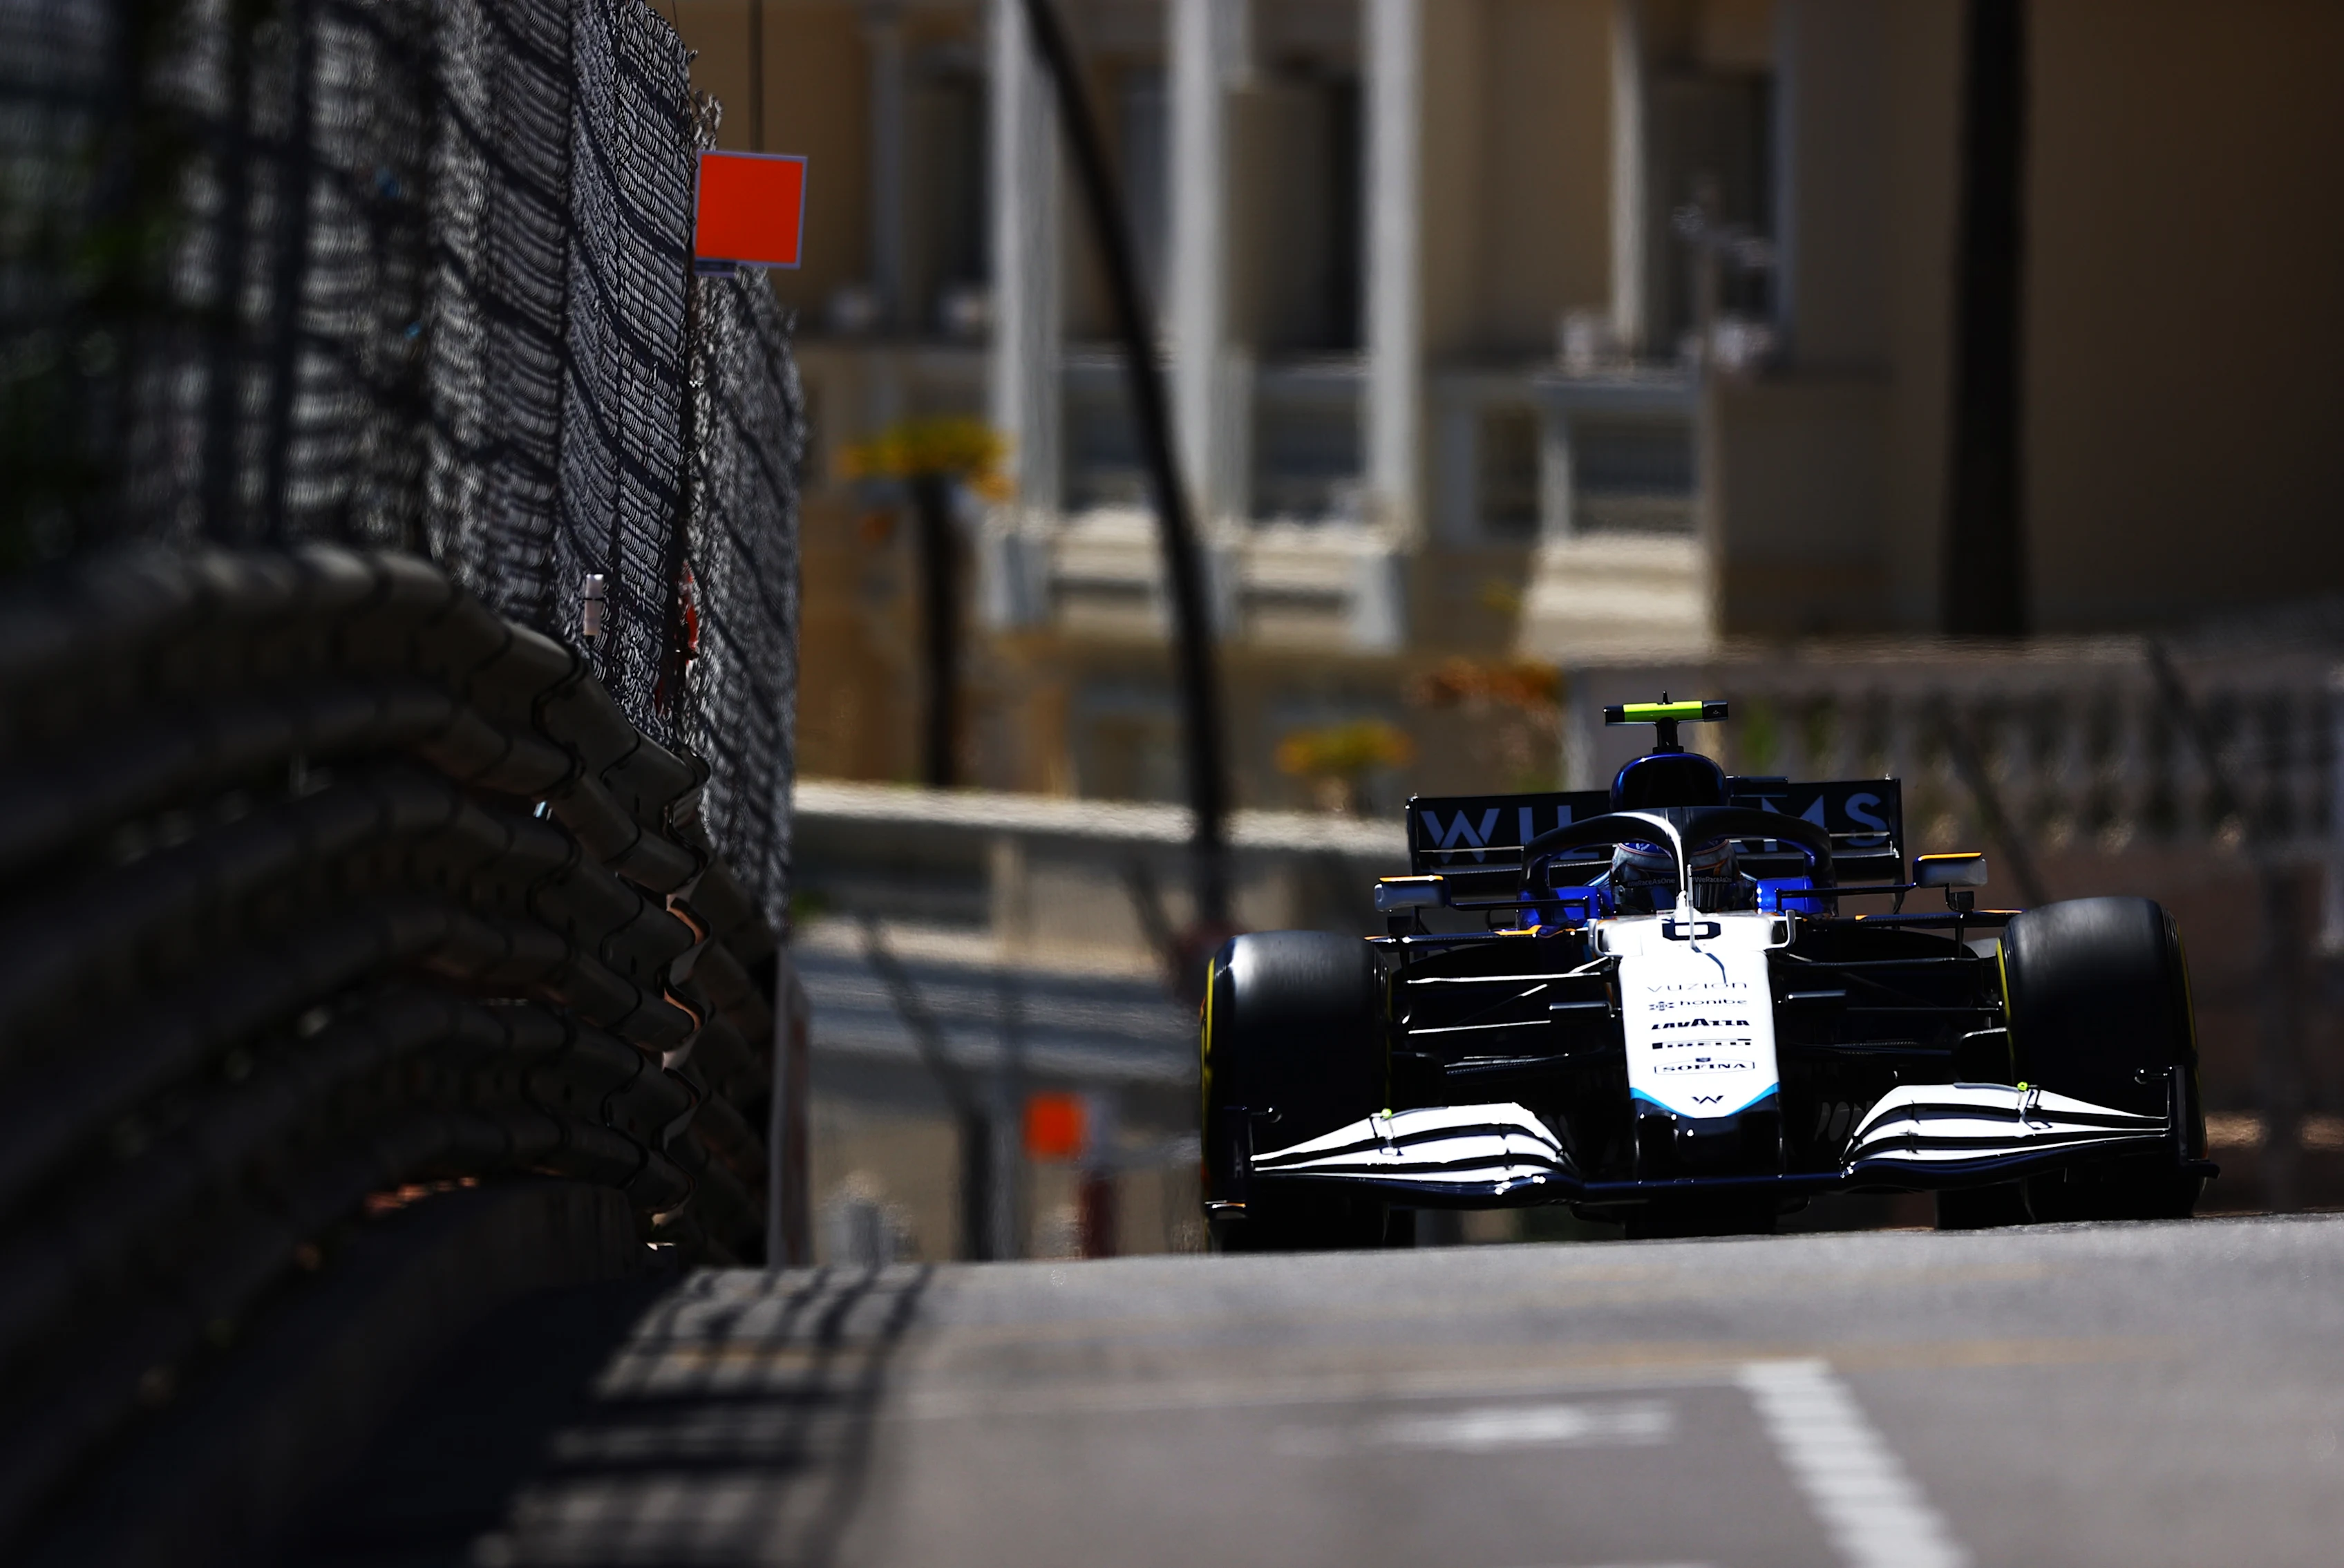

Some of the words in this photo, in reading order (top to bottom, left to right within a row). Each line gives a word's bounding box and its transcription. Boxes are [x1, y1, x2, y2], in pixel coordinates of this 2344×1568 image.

[1419, 793, 1892, 864] WILMS
[1651, 1018, 1750, 1030] LAVAZZA
[1663, 1063, 1747, 1072] SOFINA
